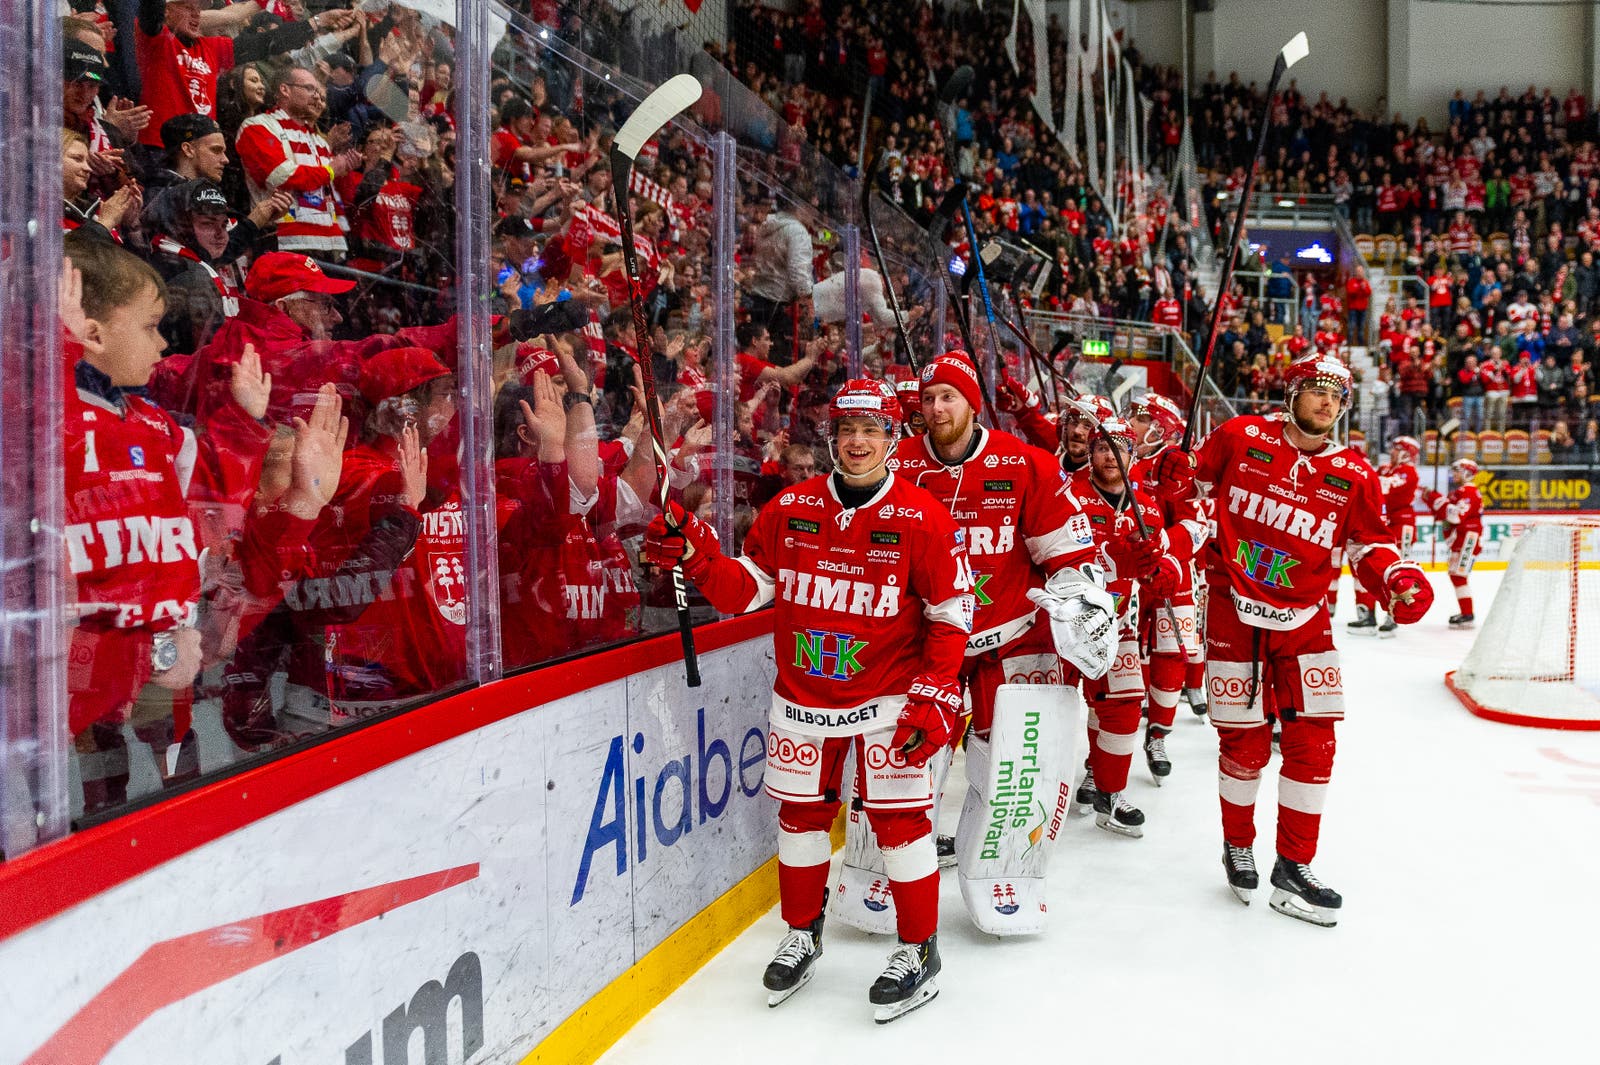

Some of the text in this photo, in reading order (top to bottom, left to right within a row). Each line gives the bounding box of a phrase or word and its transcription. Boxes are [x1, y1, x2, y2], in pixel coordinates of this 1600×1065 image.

[1260, 432, 1281, 446] SCA
[903, 459, 927, 468] SCA
[1001, 455, 1026, 465] SCA
[1347, 462, 1369, 479] SCA
[797, 495, 825, 508] SCA
[1268, 484, 1308, 504] stadium
[1316, 488, 1348, 503] JOWIC
[897, 508, 923, 520] SCA
[1229, 486, 1338, 549] TIMRÅ
[867, 550, 900, 559] JOWIC
[1232, 539, 1301, 589] NHK
[817, 560, 865, 576] stadium
[778, 569, 901, 618] TIMRÅ
[792, 629, 869, 681] NHK
[908, 682, 963, 710] BAUER
[785, 704, 879, 727] BILBOLAGET
[768, 733, 818, 766] LBM
[1012, 711, 1041, 829] norrlands
[980, 761, 1014, 860] miljövård
[1047, 782, 1069, 841] BAUER
